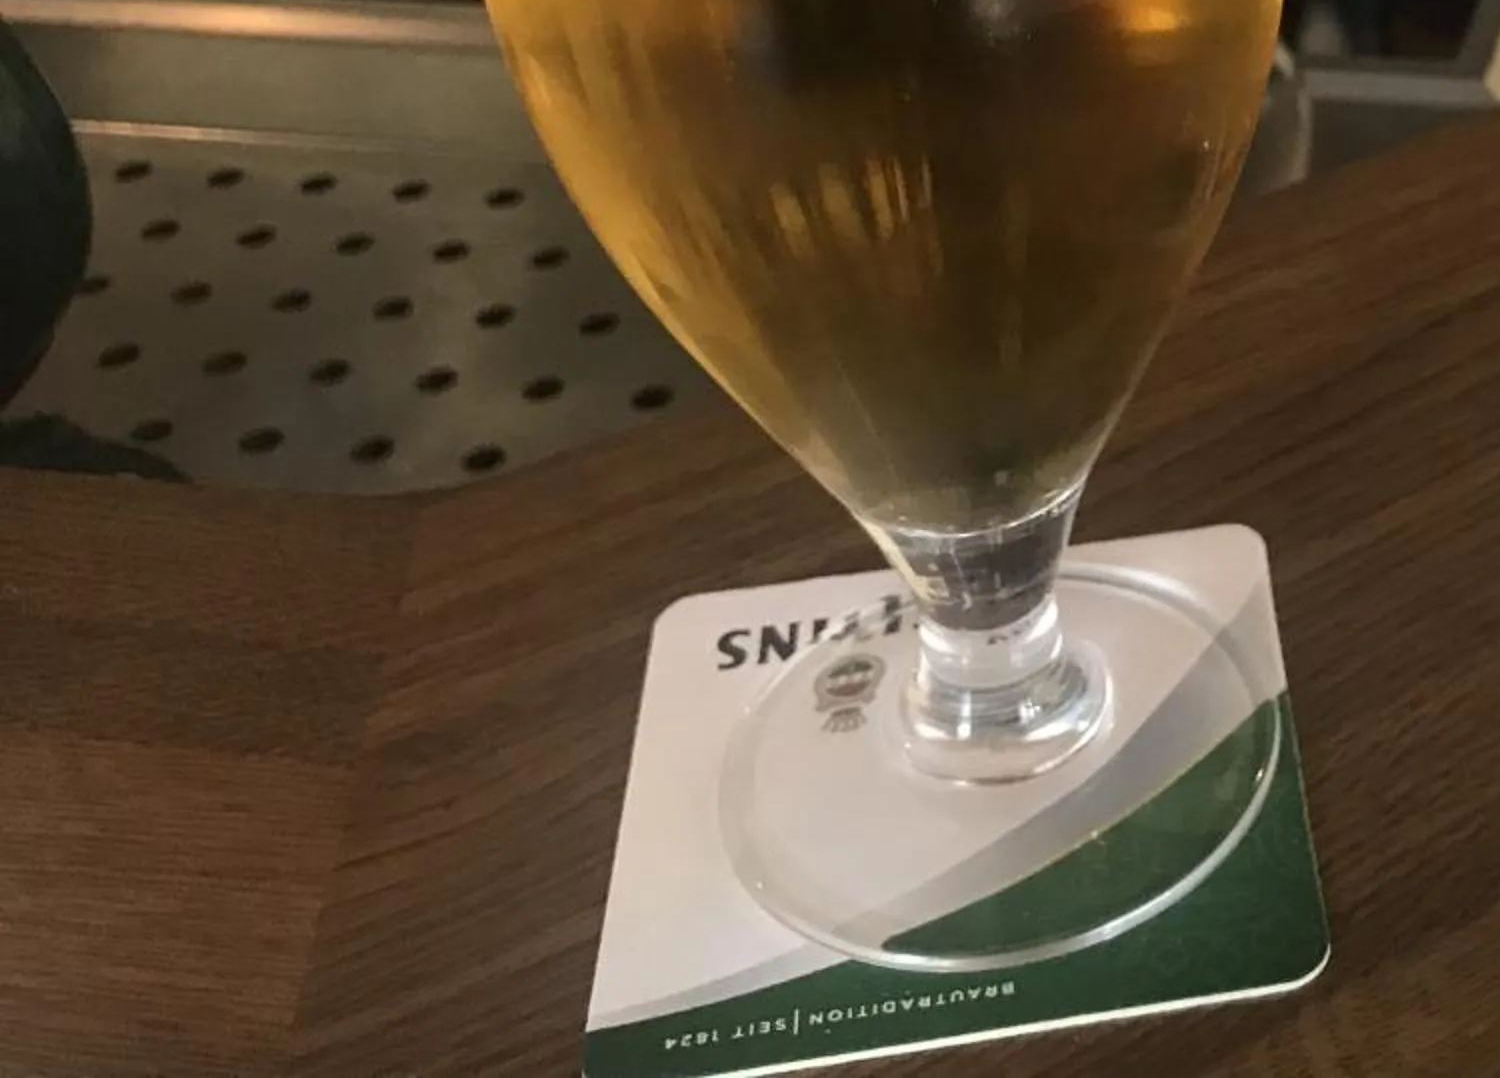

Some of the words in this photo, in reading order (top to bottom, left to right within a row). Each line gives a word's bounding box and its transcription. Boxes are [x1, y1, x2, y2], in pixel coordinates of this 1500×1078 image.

[808, 981, 1016, 1026] BRAUTRADITION
[664, 1028, 719, 1051] 1824
[731, 1017, 787, 1041] SEIT
